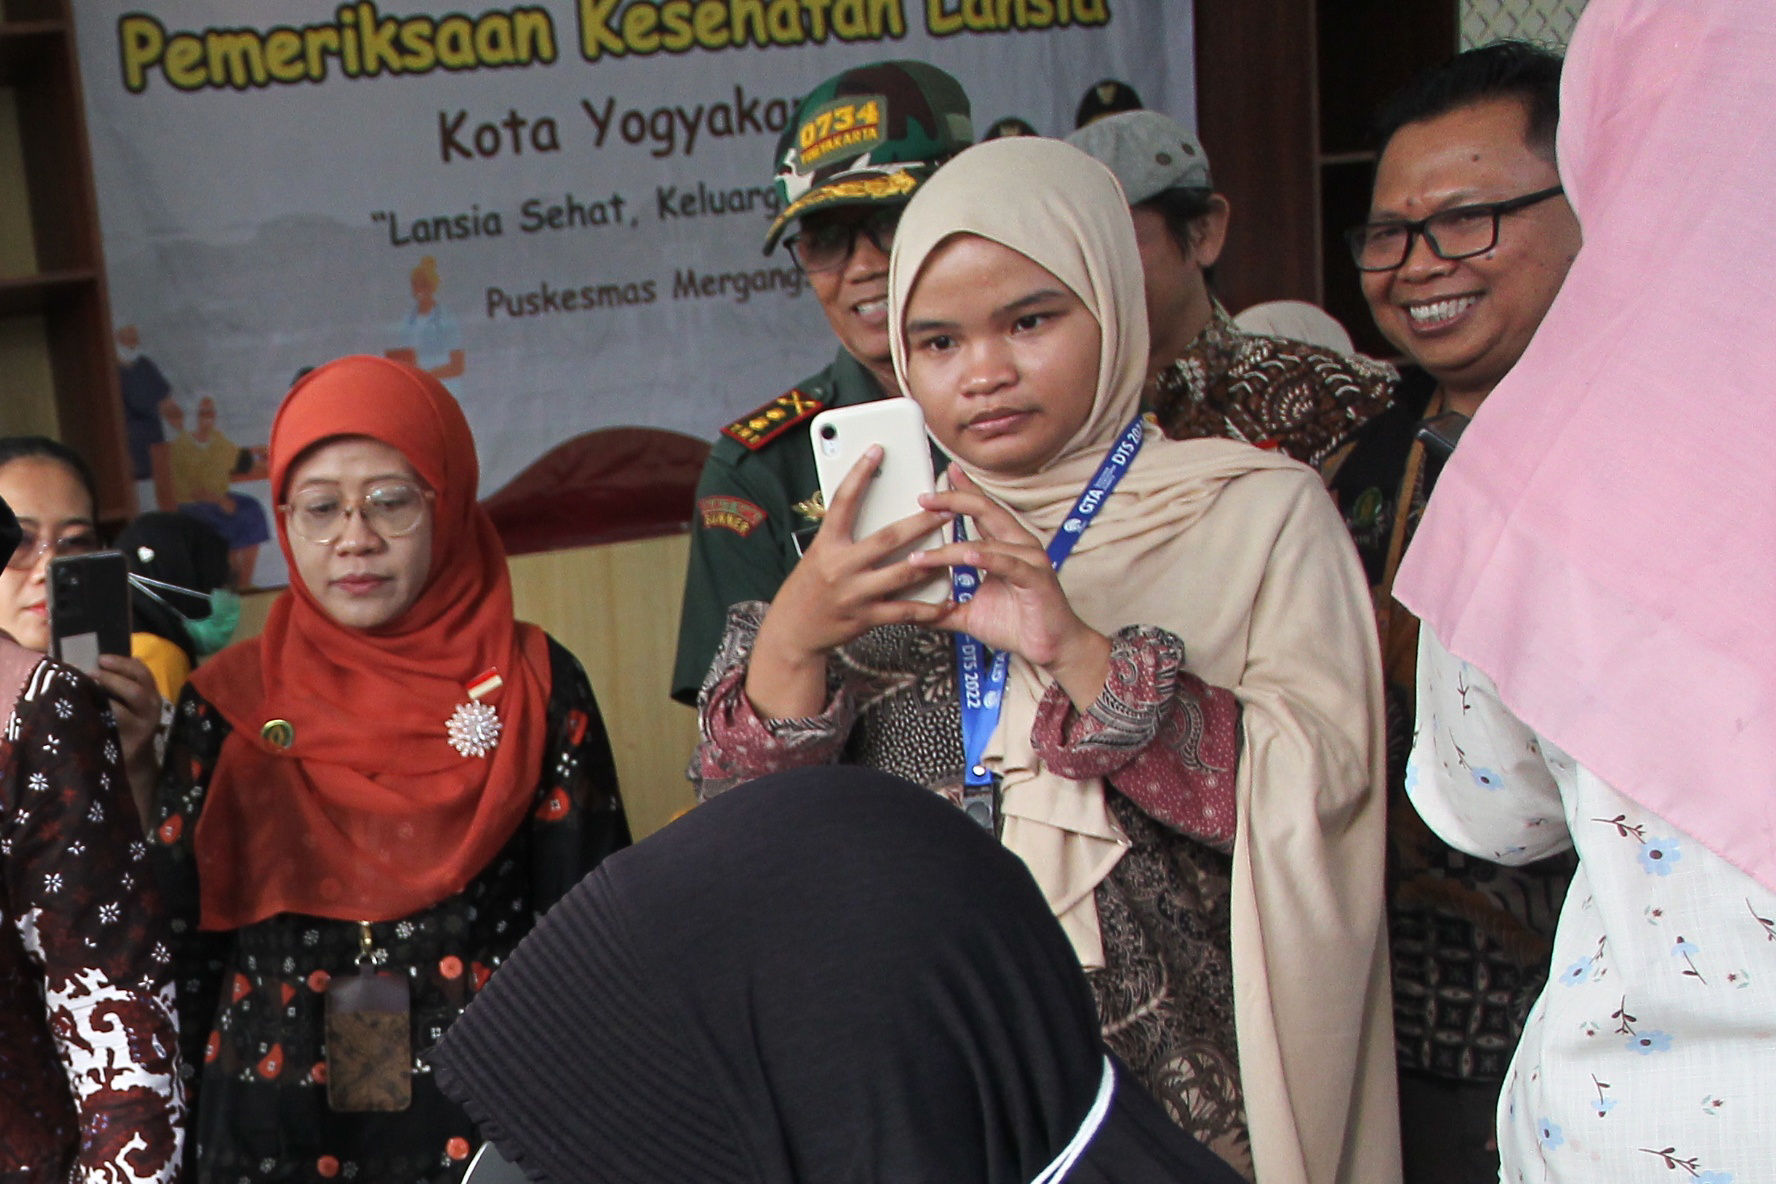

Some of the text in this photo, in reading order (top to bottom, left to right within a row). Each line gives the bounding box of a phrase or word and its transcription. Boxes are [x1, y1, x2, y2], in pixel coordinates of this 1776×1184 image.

[118, 0, 1111, 94] Pemeriksaan Kesehatan Lansia
[438, 109, 561, 162] Kota
[800, 100, 880, 149] 0734
[521, 194, 638, 233] Sehat,
[657, 182, 783, 220] Keluarg
[485, 264, 814, 319] Puskesmas Mergang
[1078, 489, 1104, 514] GTA
[1111, 441, 1135, 466] DTS
[962, 644, 982, 709] DTS 2022
